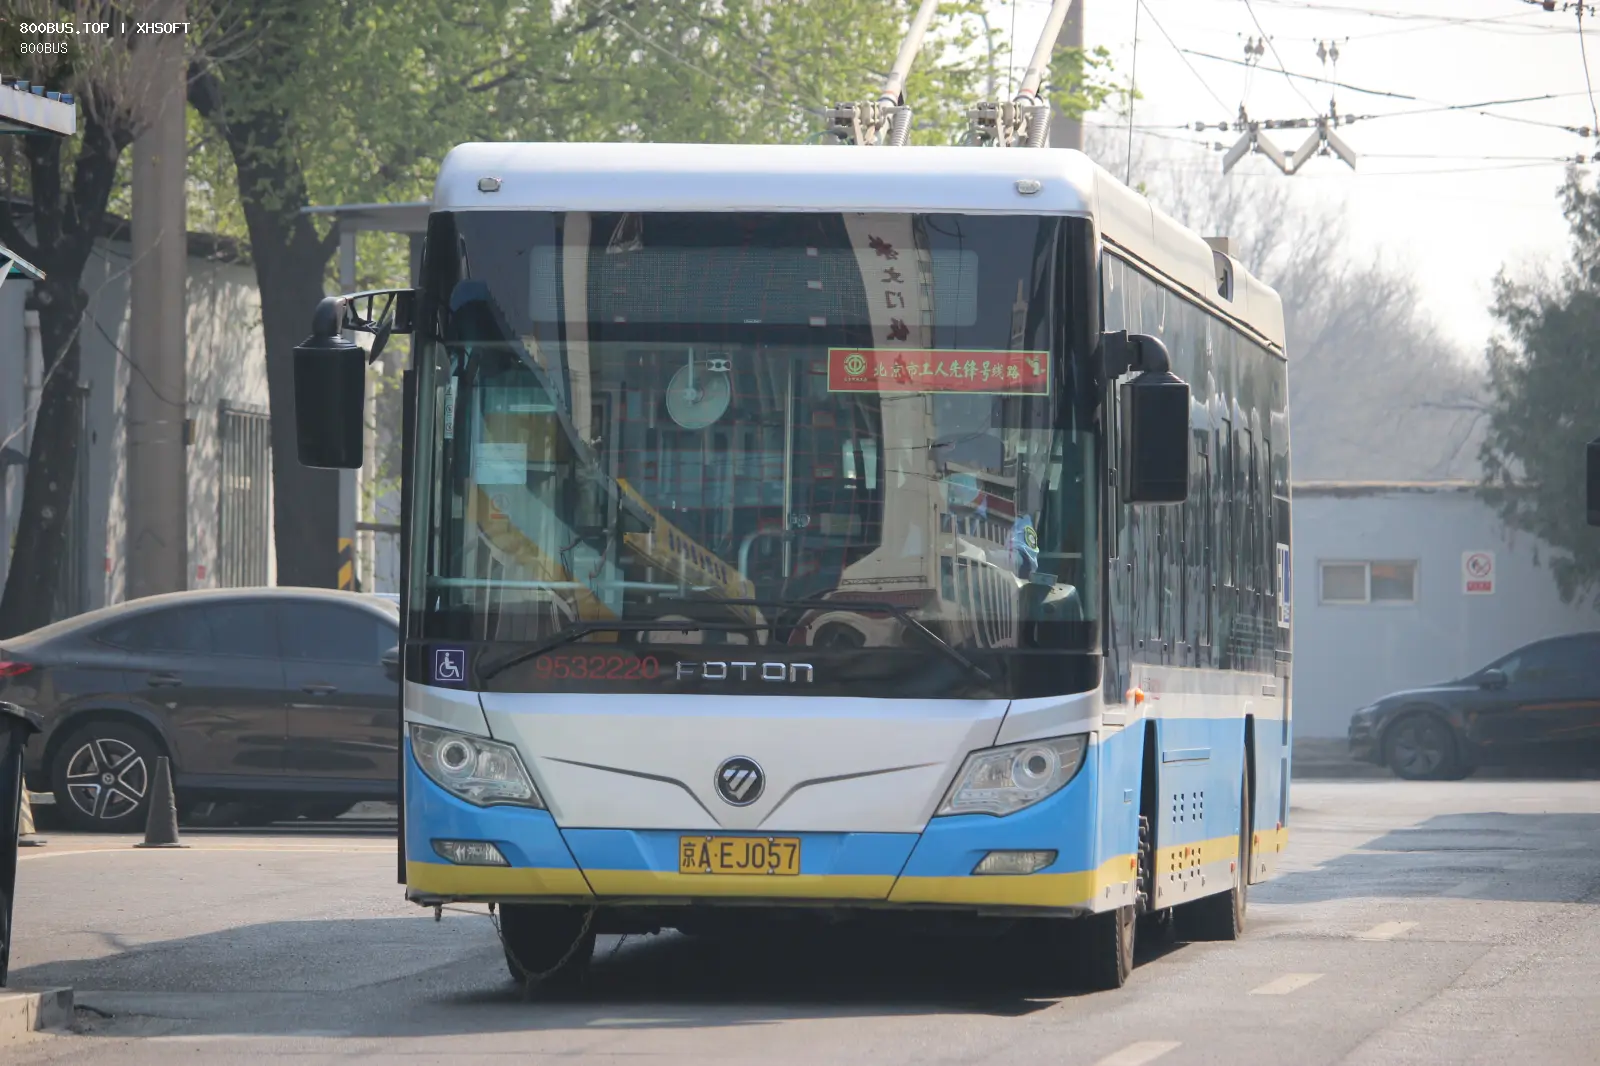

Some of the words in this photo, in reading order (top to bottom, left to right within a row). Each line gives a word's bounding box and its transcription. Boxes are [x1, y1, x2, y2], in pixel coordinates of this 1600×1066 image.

[873, 358, 1020, 382] 北京市工人先锋号线路
[535, 655, 660, 680] 9532220
[675, 660, 815, 683] FOTON
